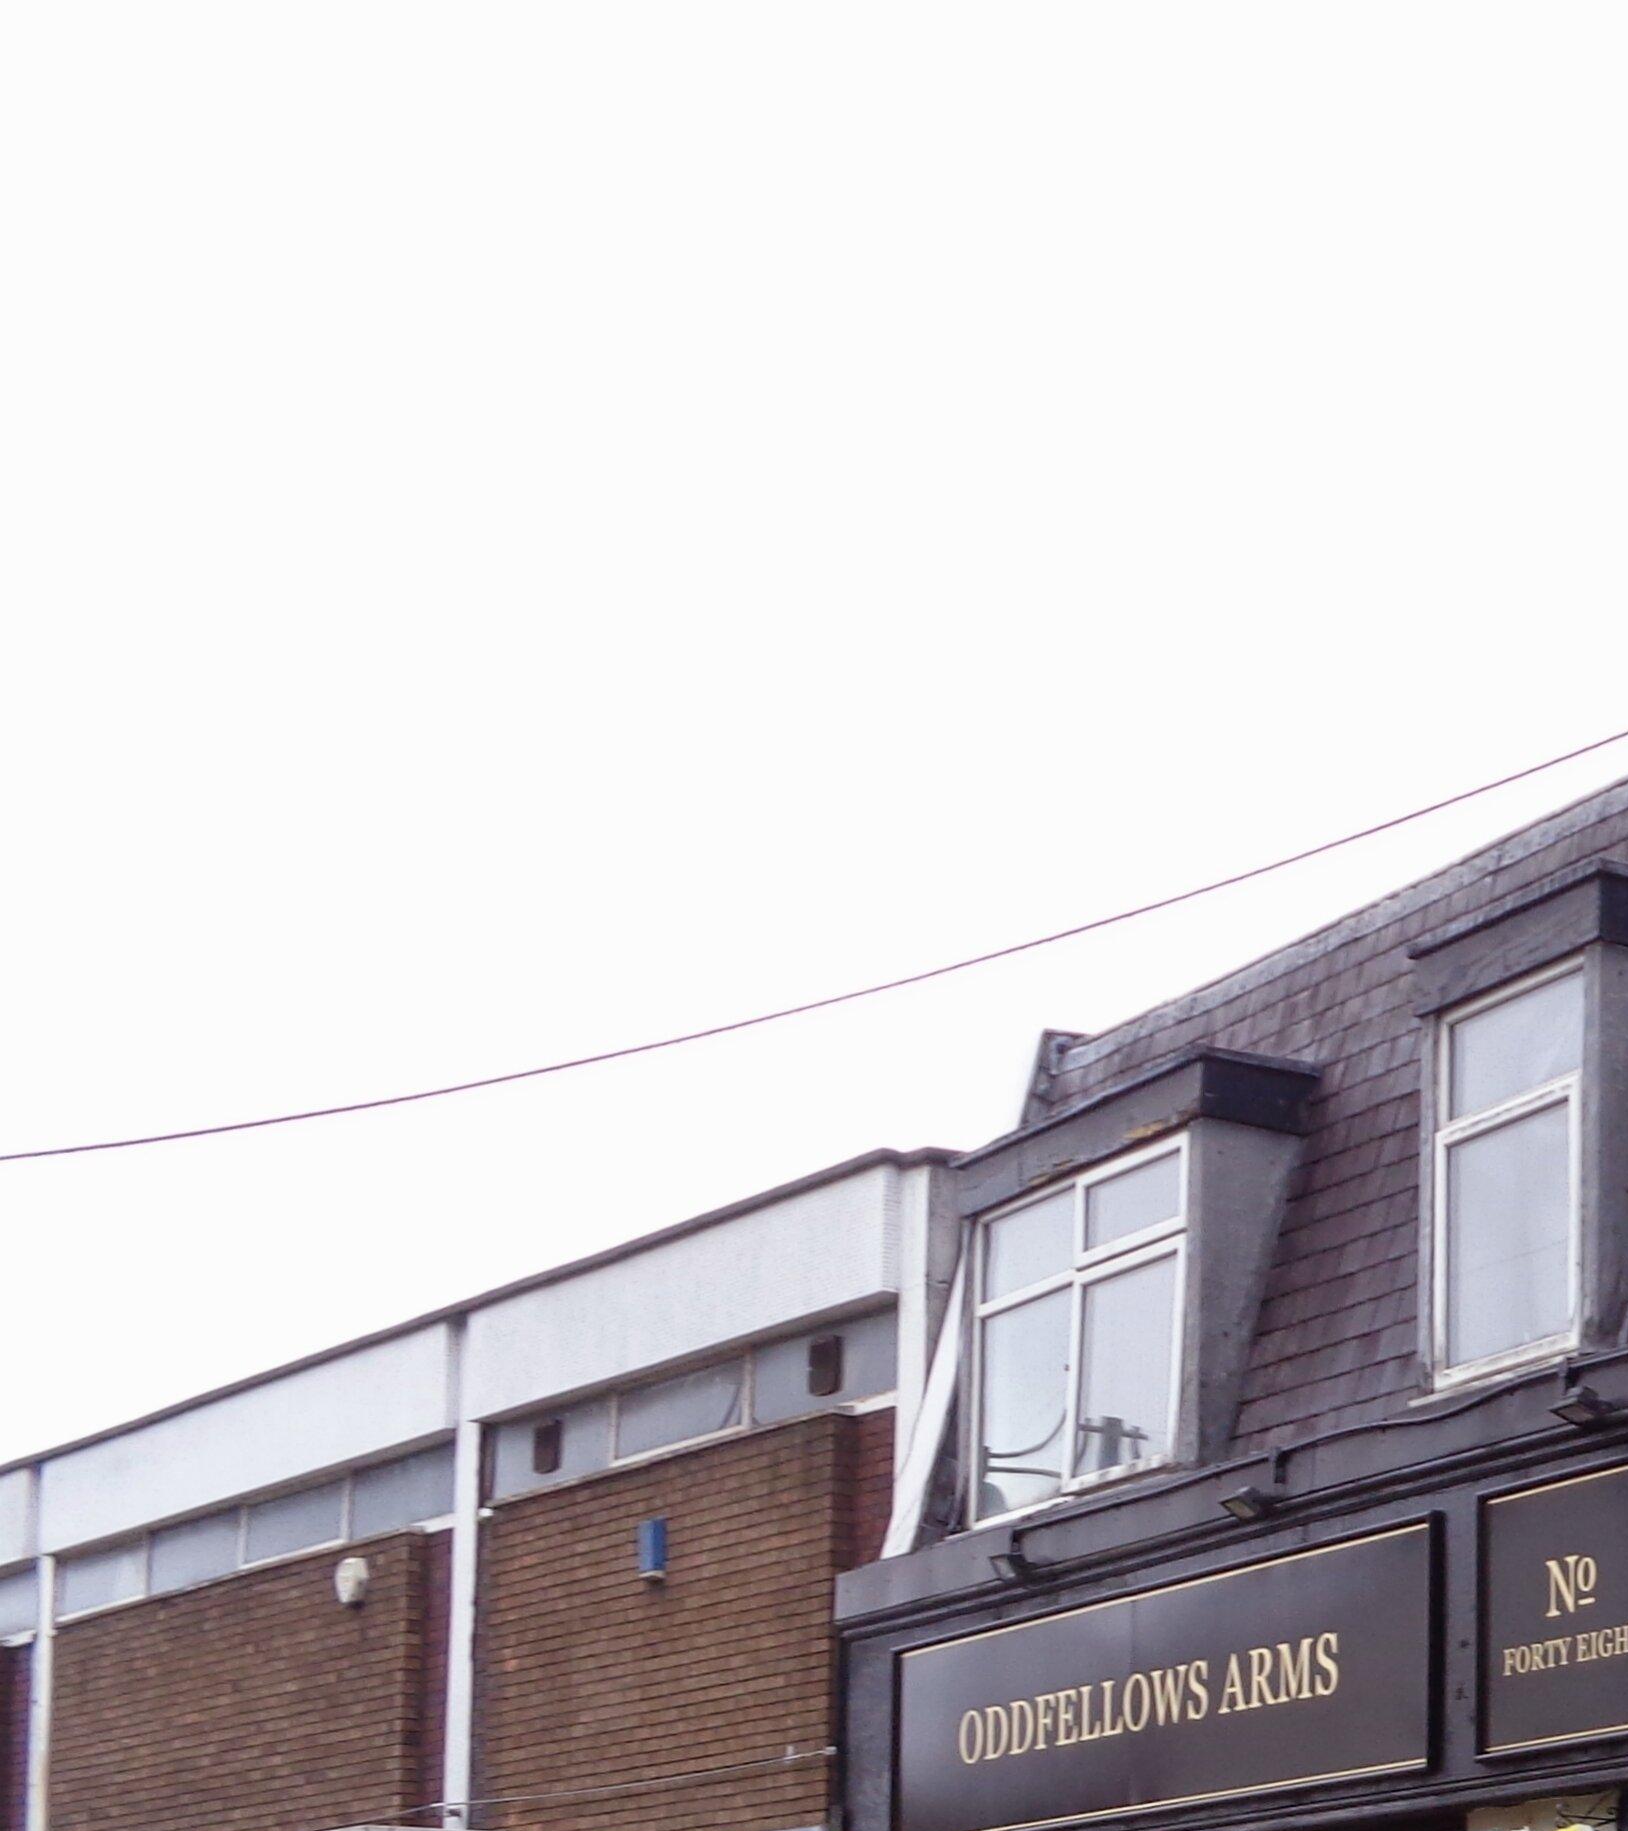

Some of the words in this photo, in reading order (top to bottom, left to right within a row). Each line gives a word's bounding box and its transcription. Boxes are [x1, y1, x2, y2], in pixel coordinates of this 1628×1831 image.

[958, 1659, 1209, 1765] ODDFELLOWS
[1217, 1632, 1339, 1714] ARMS
[1502, 1636, 1573, 1676] FORTY
